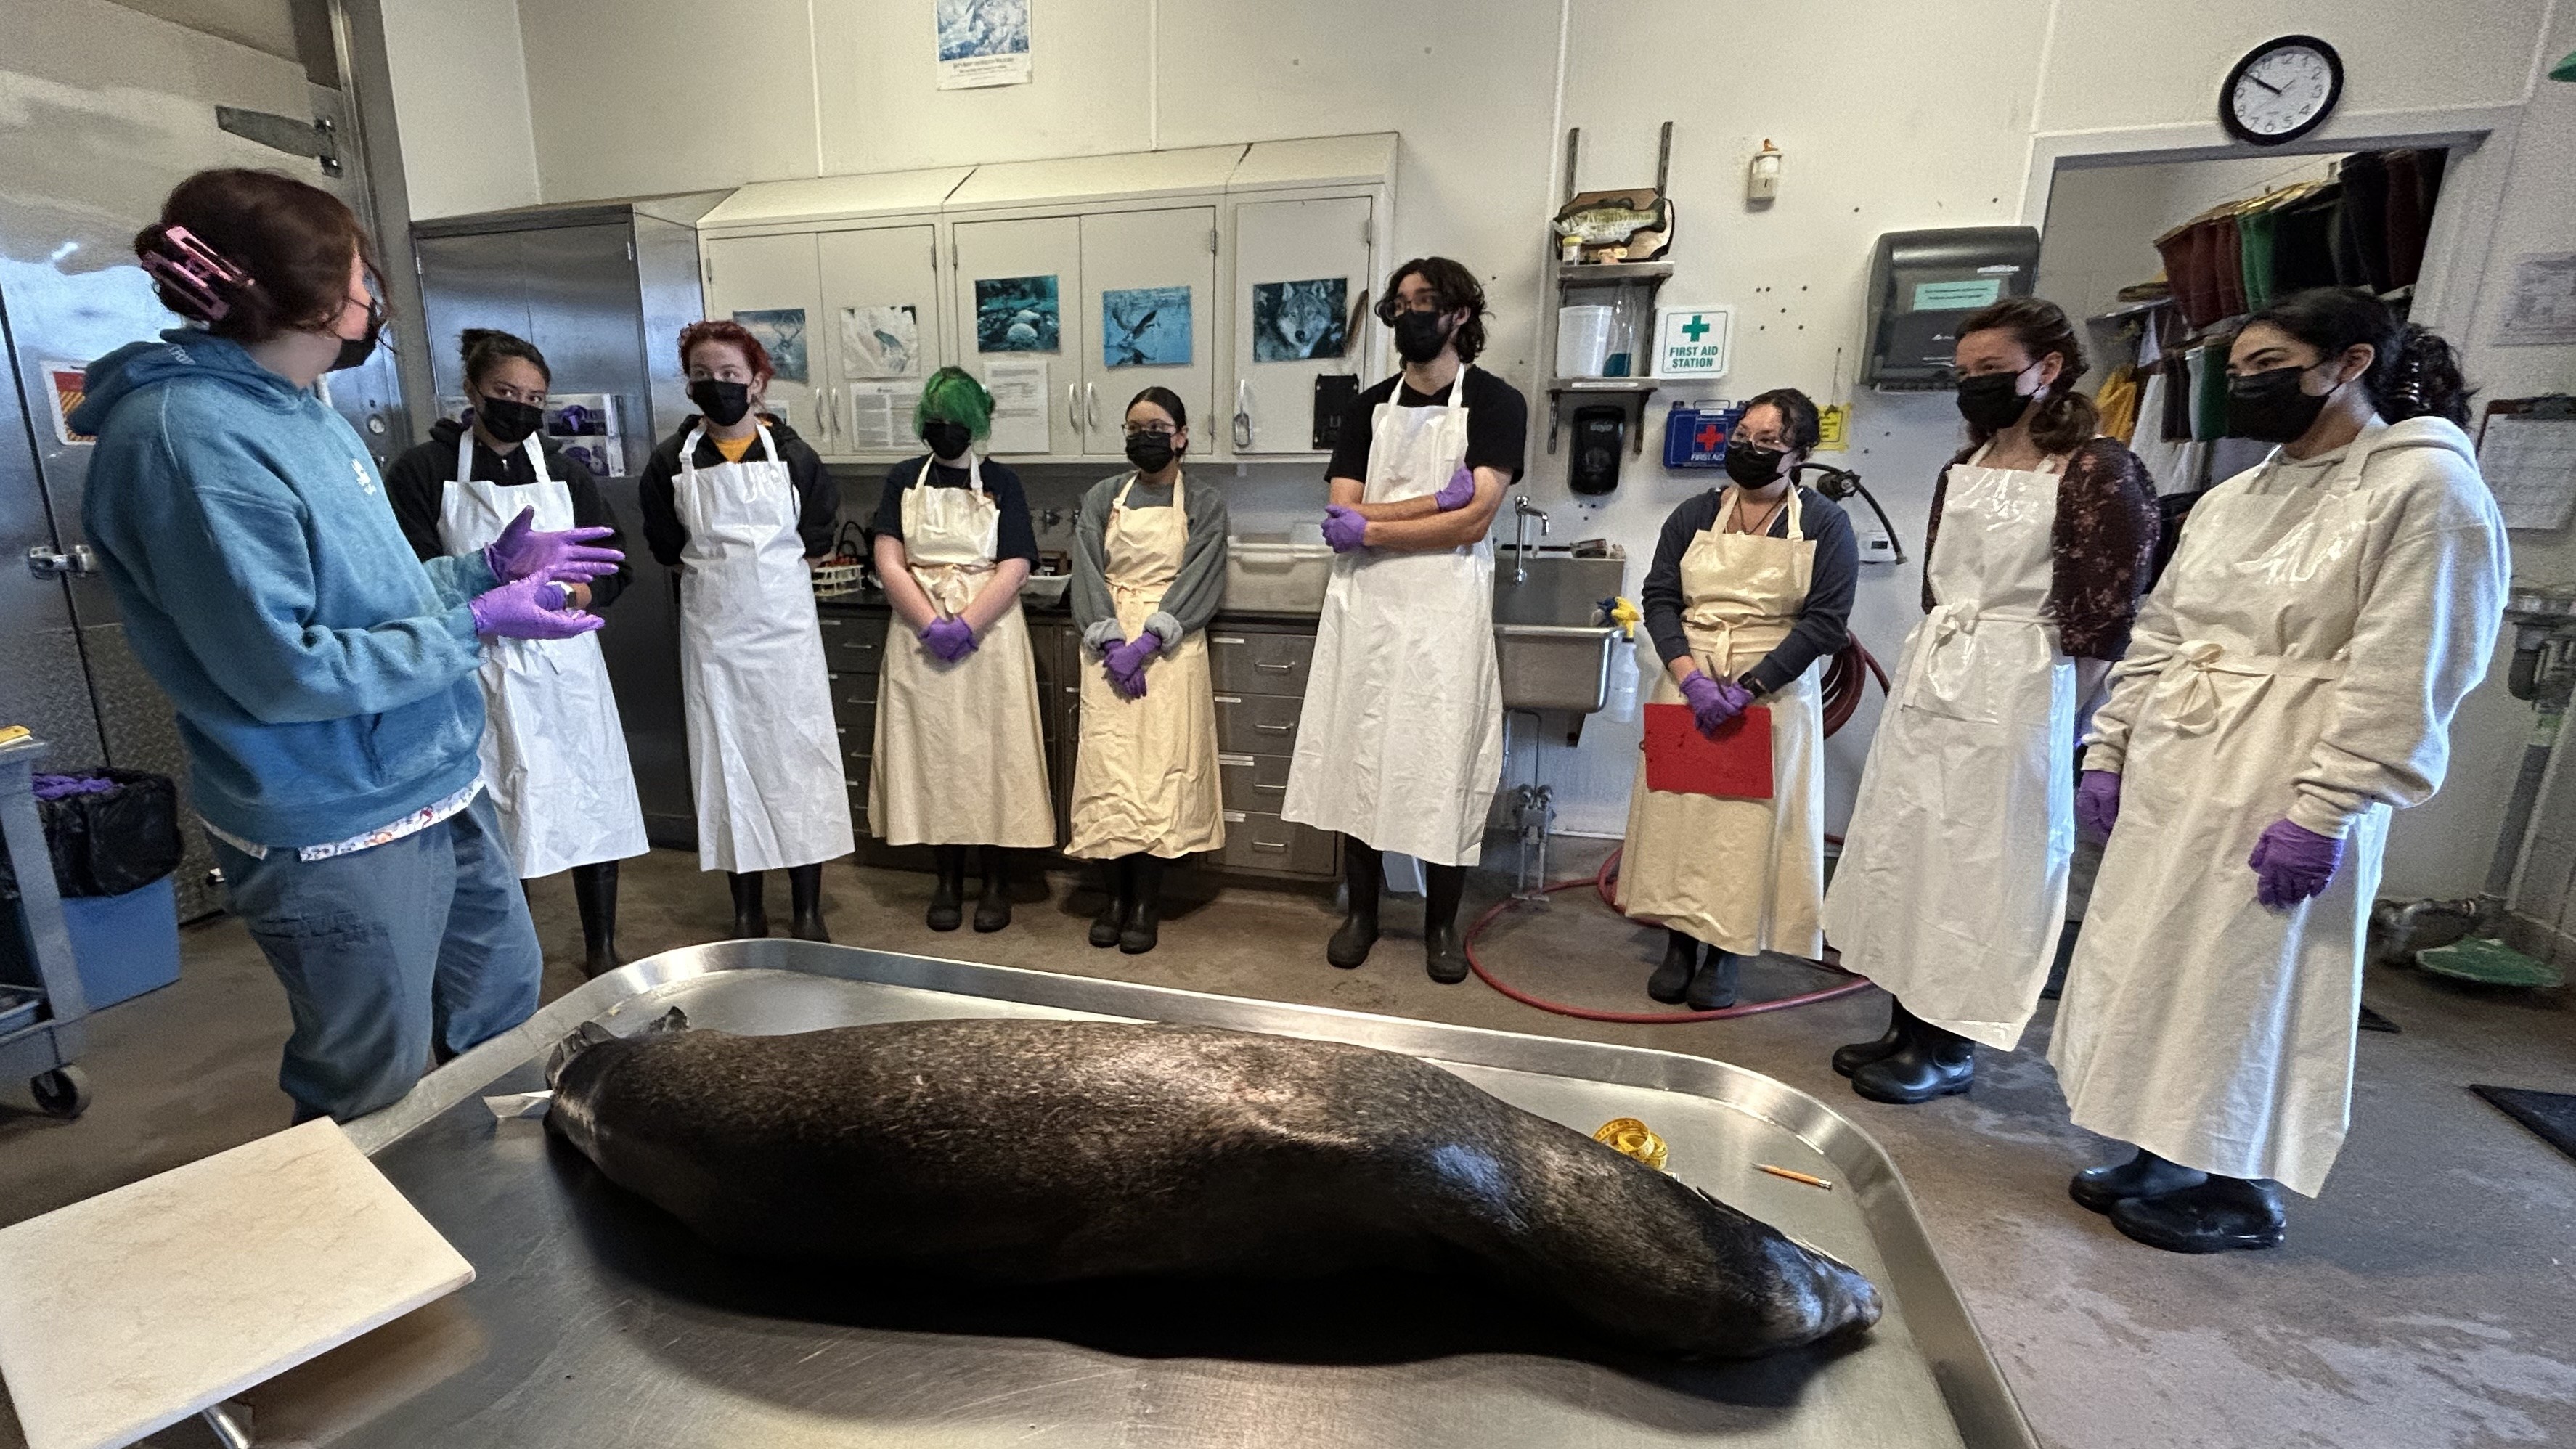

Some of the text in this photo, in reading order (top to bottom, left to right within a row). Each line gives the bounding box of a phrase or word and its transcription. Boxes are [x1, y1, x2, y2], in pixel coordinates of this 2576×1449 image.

[2299, 103, 2311, 115] 4
[2264, 120, 2276, 133] 6
[1669, 346, 1719, 357] FIRST AID
[1671, 357, 1713, 369] STATION
[1690, 452, 1711, 462] FIRST
